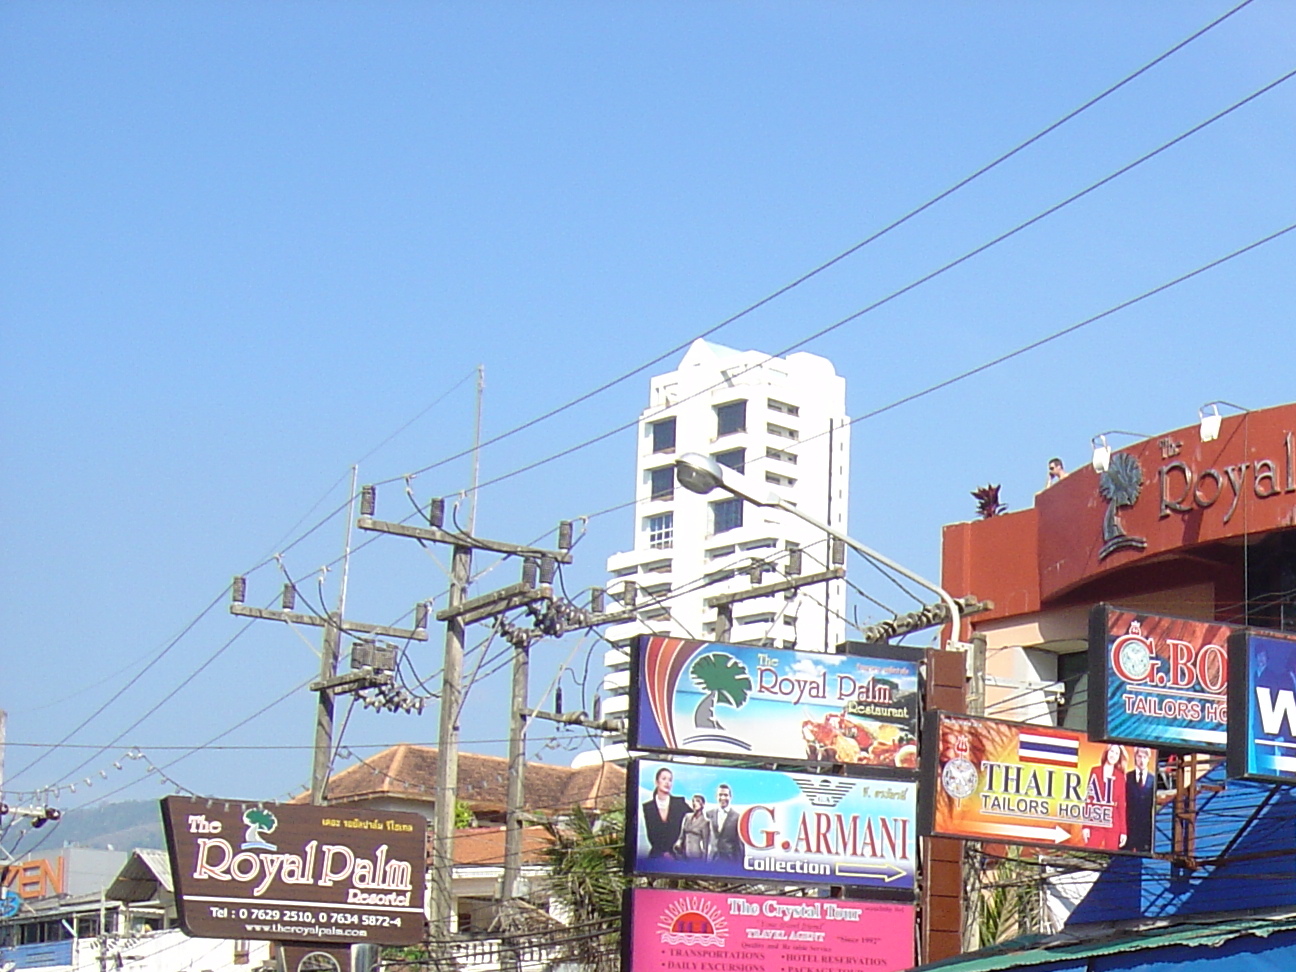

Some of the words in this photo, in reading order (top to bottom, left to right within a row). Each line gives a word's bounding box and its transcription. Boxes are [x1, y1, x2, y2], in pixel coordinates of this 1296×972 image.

[1158, 437, 1184, 460] The
[757, 654, 779, 668] The
[757, 667, 826, 704] Royal
[837, 676, 893, 704] Palm
[849, 701, 909, 719] Restaurant
[1123, 695, 1201, 721] TAILORS
[981, 761, 1056, 799] THAI
[1063, 769, 1117, 806] RAI
[981, 794, 1049, 814] TAILORS
[1058, 800, 1112, 823] HOUSE
[188, 815, 222, 833] The
[738, 805, 910, 859] G.ARMANI
[193, 837, 318, 896] Royal
[317, 843, 413, 890] Palm
[744, 855, 830, 875] Collection
[346, 888, 410, 907] Resortel
[210, 906, 228, 918] Tel
[251, 910, 280, 920] 7629
[283, 911, 315, 924] 2510,
[330, 913, 358, 924] 7634
[361, 914, 402, 927] 5872-4
[727, 898, 760, 916] The
[762, 900, 821, 922] Crystal
[823, 903, 862, 921] Tour
[245, 923, 368, 938] www.theroyalpalm.com
[667, 961, 698, 970] DAILY
[700, 963, 766, 972] EXCURSIONS
[670, 949, 766, 960] TRANSPORTATIONS
[786, 954, 818, 963] HOTEL
[821, 956, 887, 966] RESERVATION
